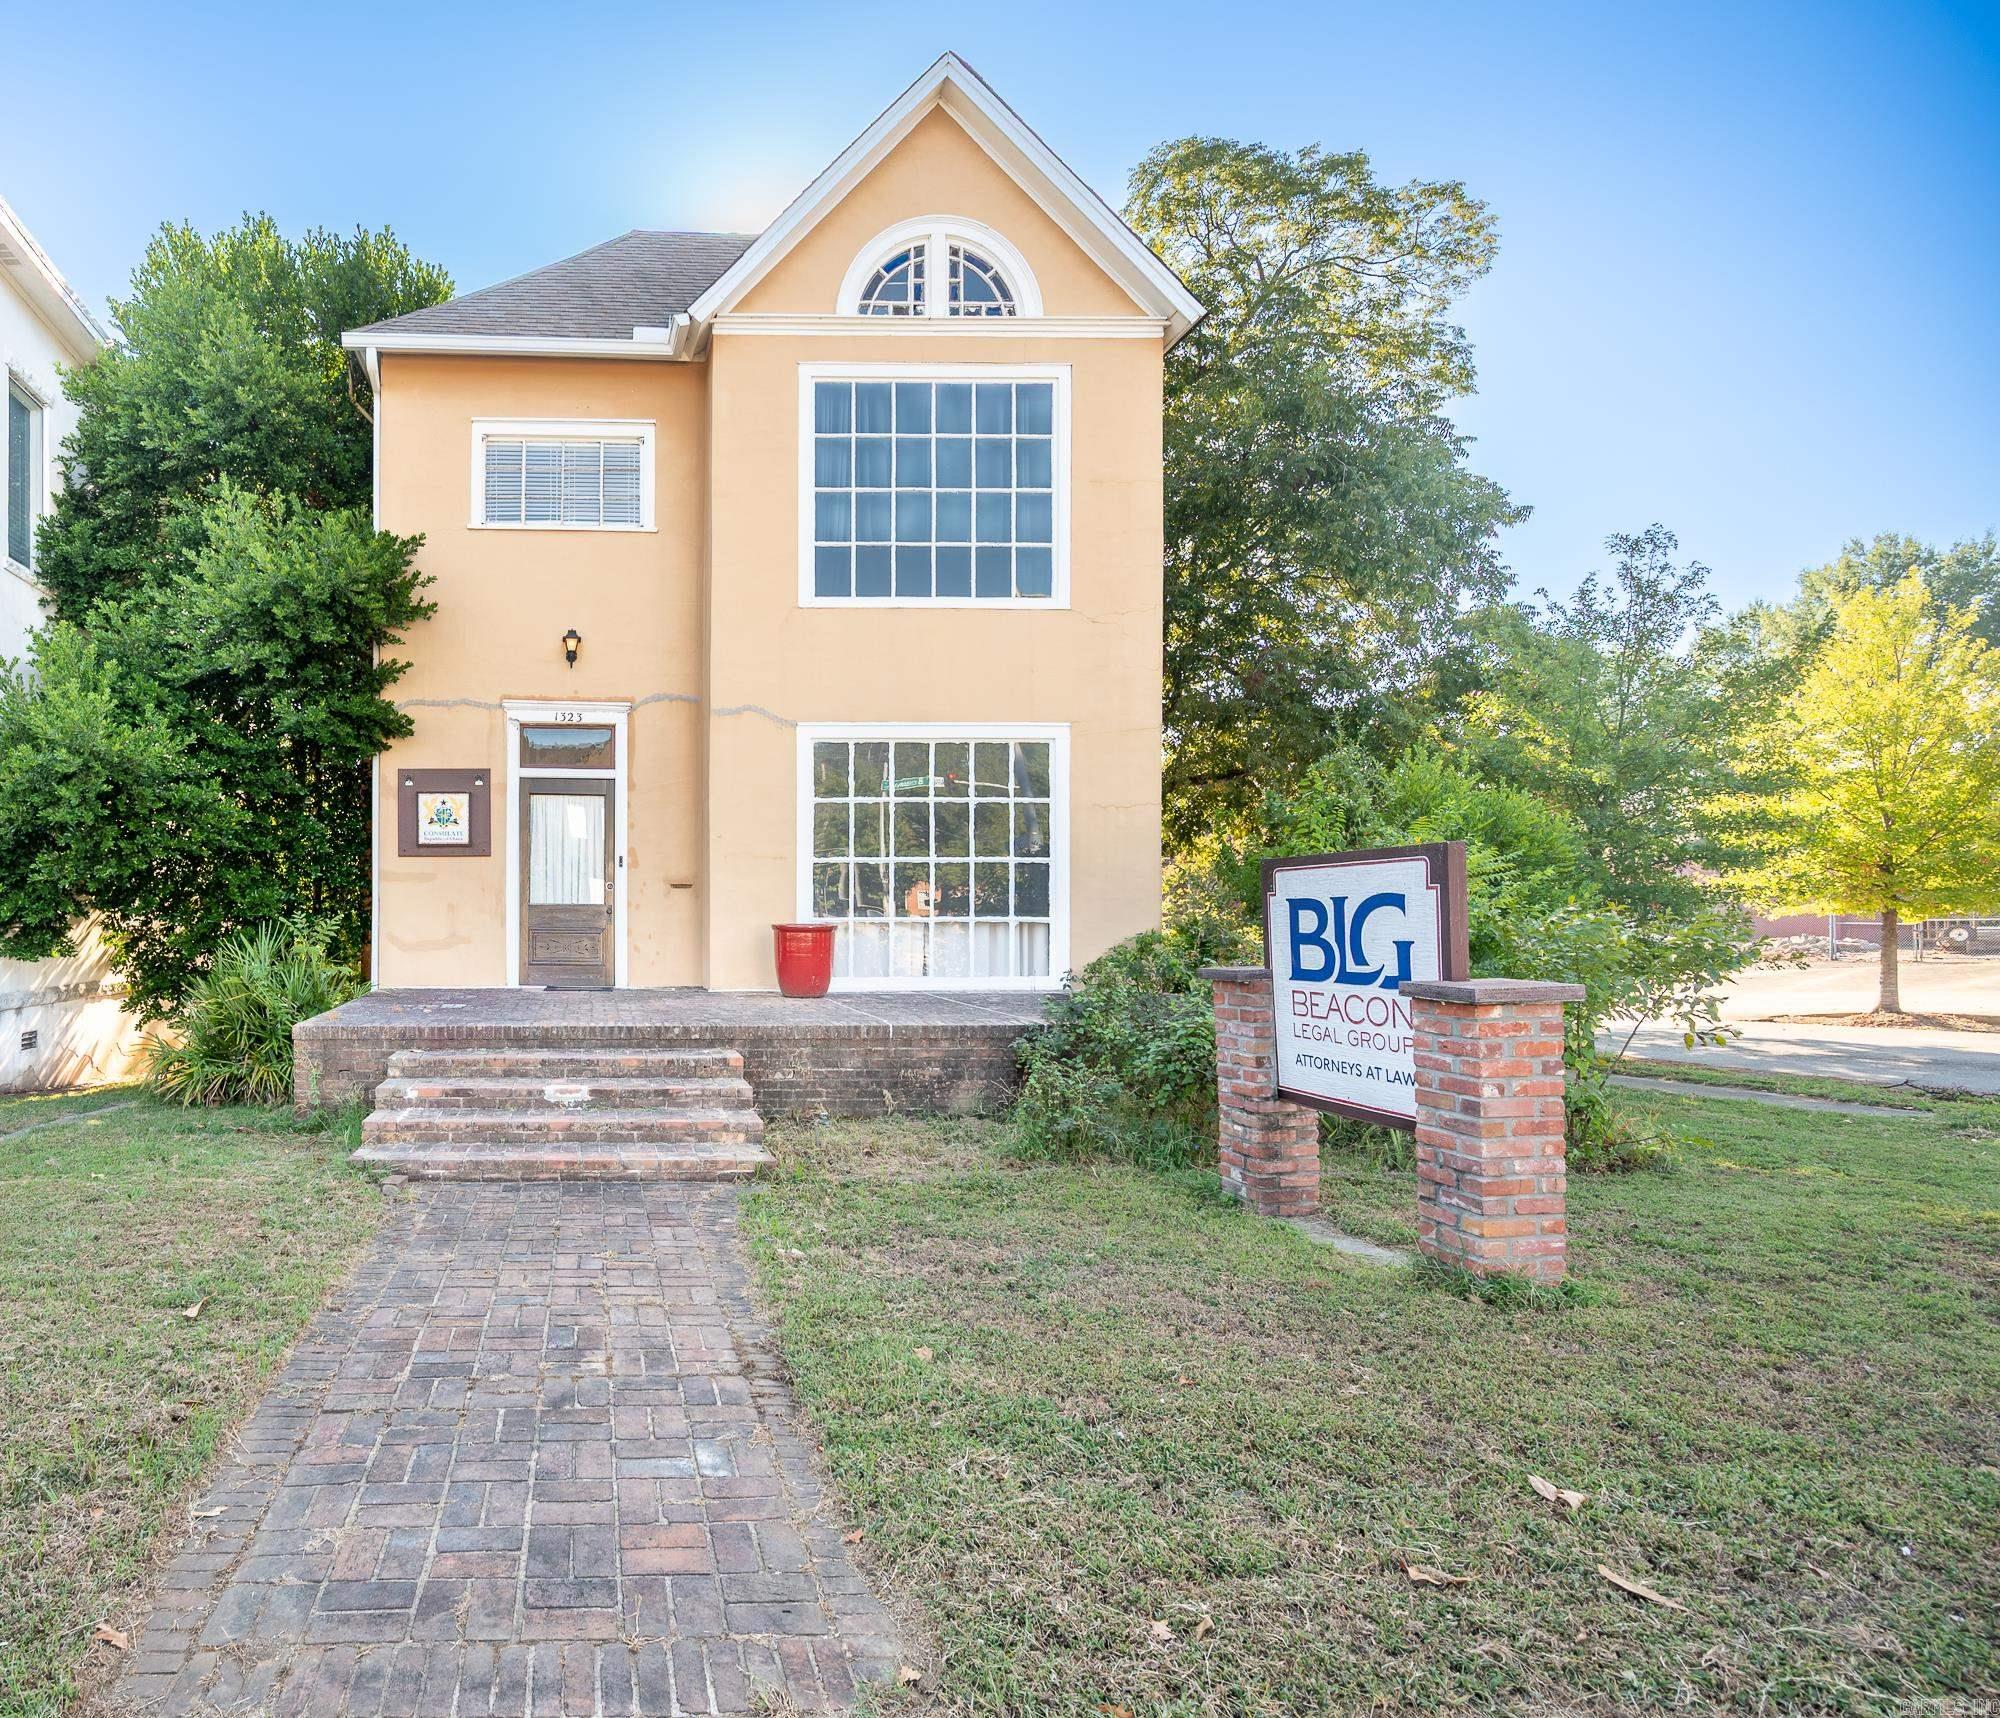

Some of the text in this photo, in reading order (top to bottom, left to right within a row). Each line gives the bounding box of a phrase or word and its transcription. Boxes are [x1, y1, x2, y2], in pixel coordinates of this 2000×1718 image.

[555, 712, 583, 723] 1323
[1286, 892, 1415, 990] BLG
[1292, 990, 1413, 1030] BEACON
[1293, 1022, 1413, 1054] LEGAL GROUP
[1295, 1053, 1416, 1086] ATTORNEYS AT LAW
